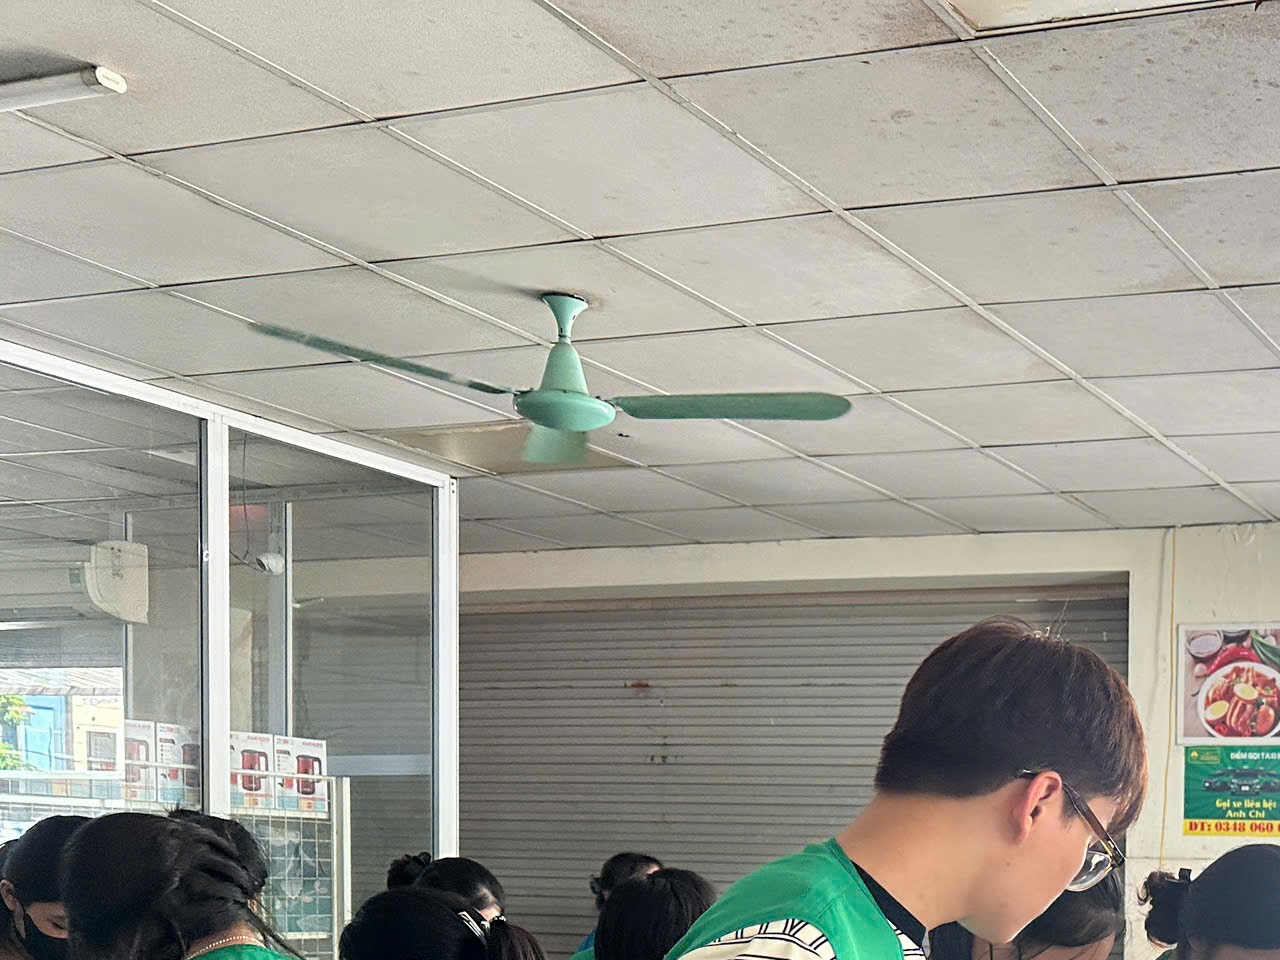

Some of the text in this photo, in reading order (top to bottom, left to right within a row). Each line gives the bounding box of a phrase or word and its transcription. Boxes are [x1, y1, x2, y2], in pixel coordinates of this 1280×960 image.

[1261, 752, 1277, 760] TAXI
[1225, 810, 1246, 818] Anh
[1214, 821, 1246, 832] 0348
[1249, 822, 1274, 833] 060
